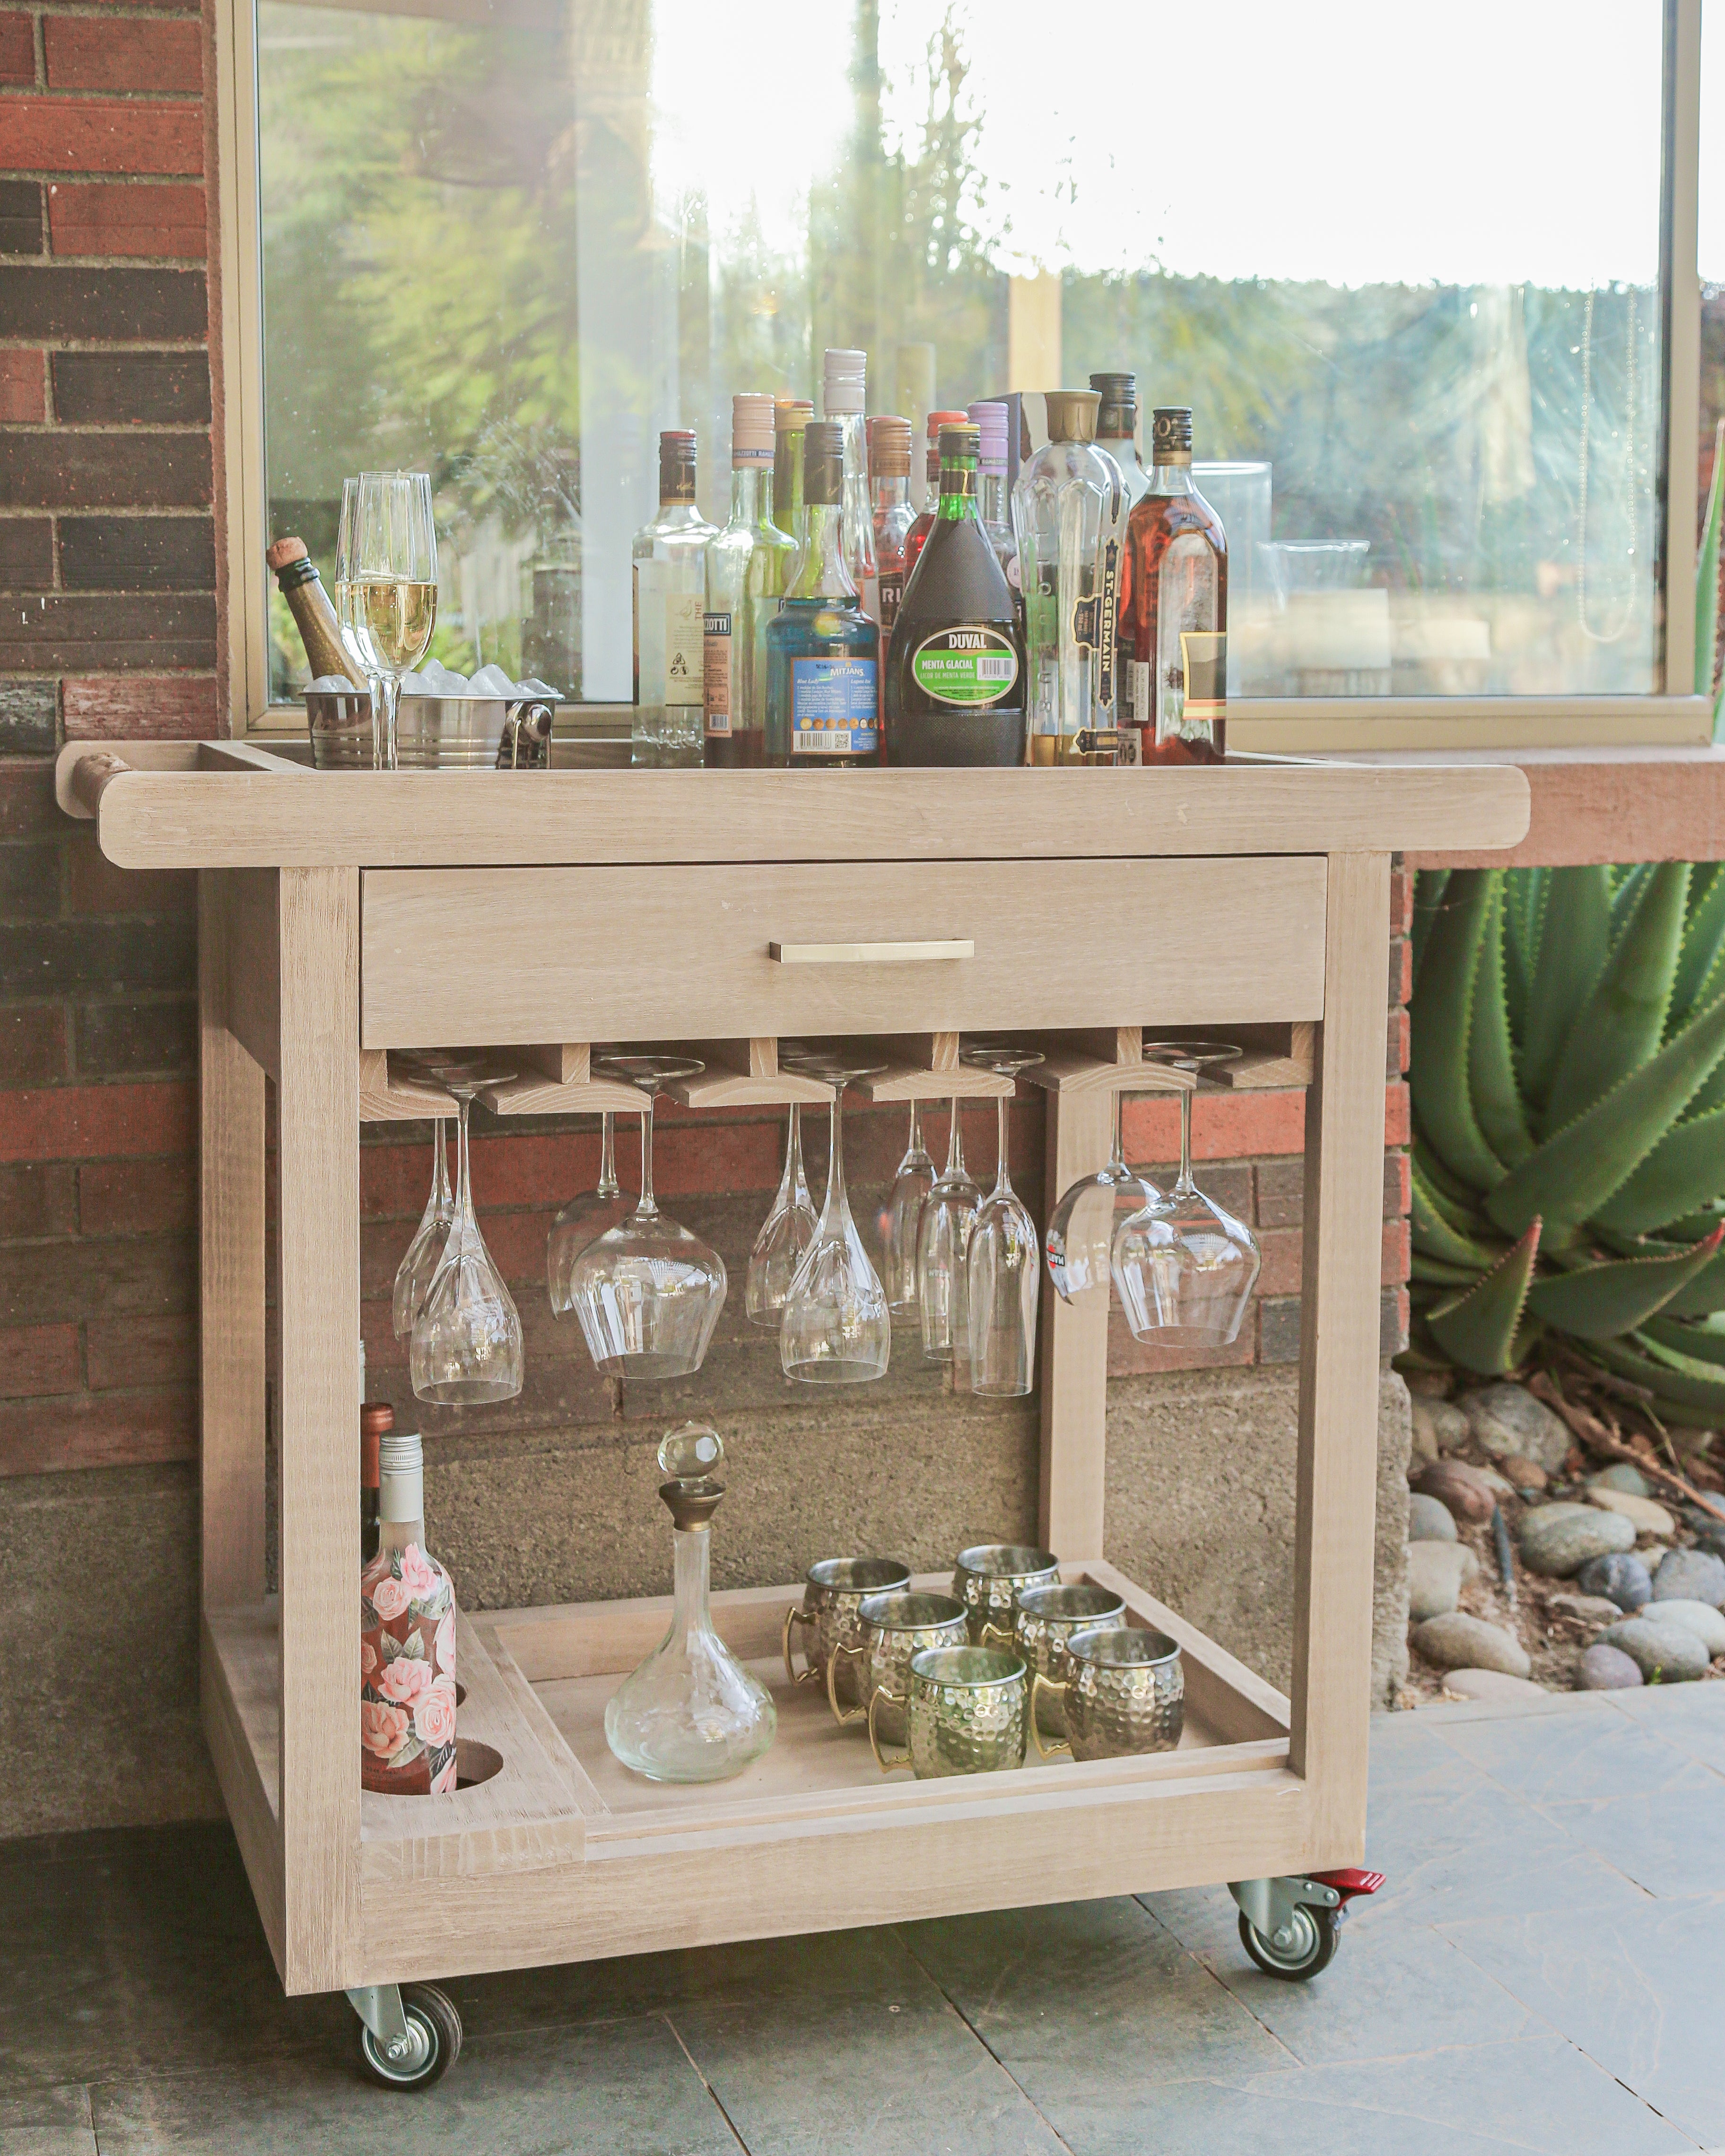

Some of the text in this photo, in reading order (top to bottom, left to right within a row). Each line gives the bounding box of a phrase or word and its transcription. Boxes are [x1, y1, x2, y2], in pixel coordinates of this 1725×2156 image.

[1102, 570, 1115, 672] ST-GERMAIN
[949, 634, 987, 649] DUVAL
[922, 660, 974, 669] MENTA GLACIAL
[830, 668, 864, 676] MITJANS
